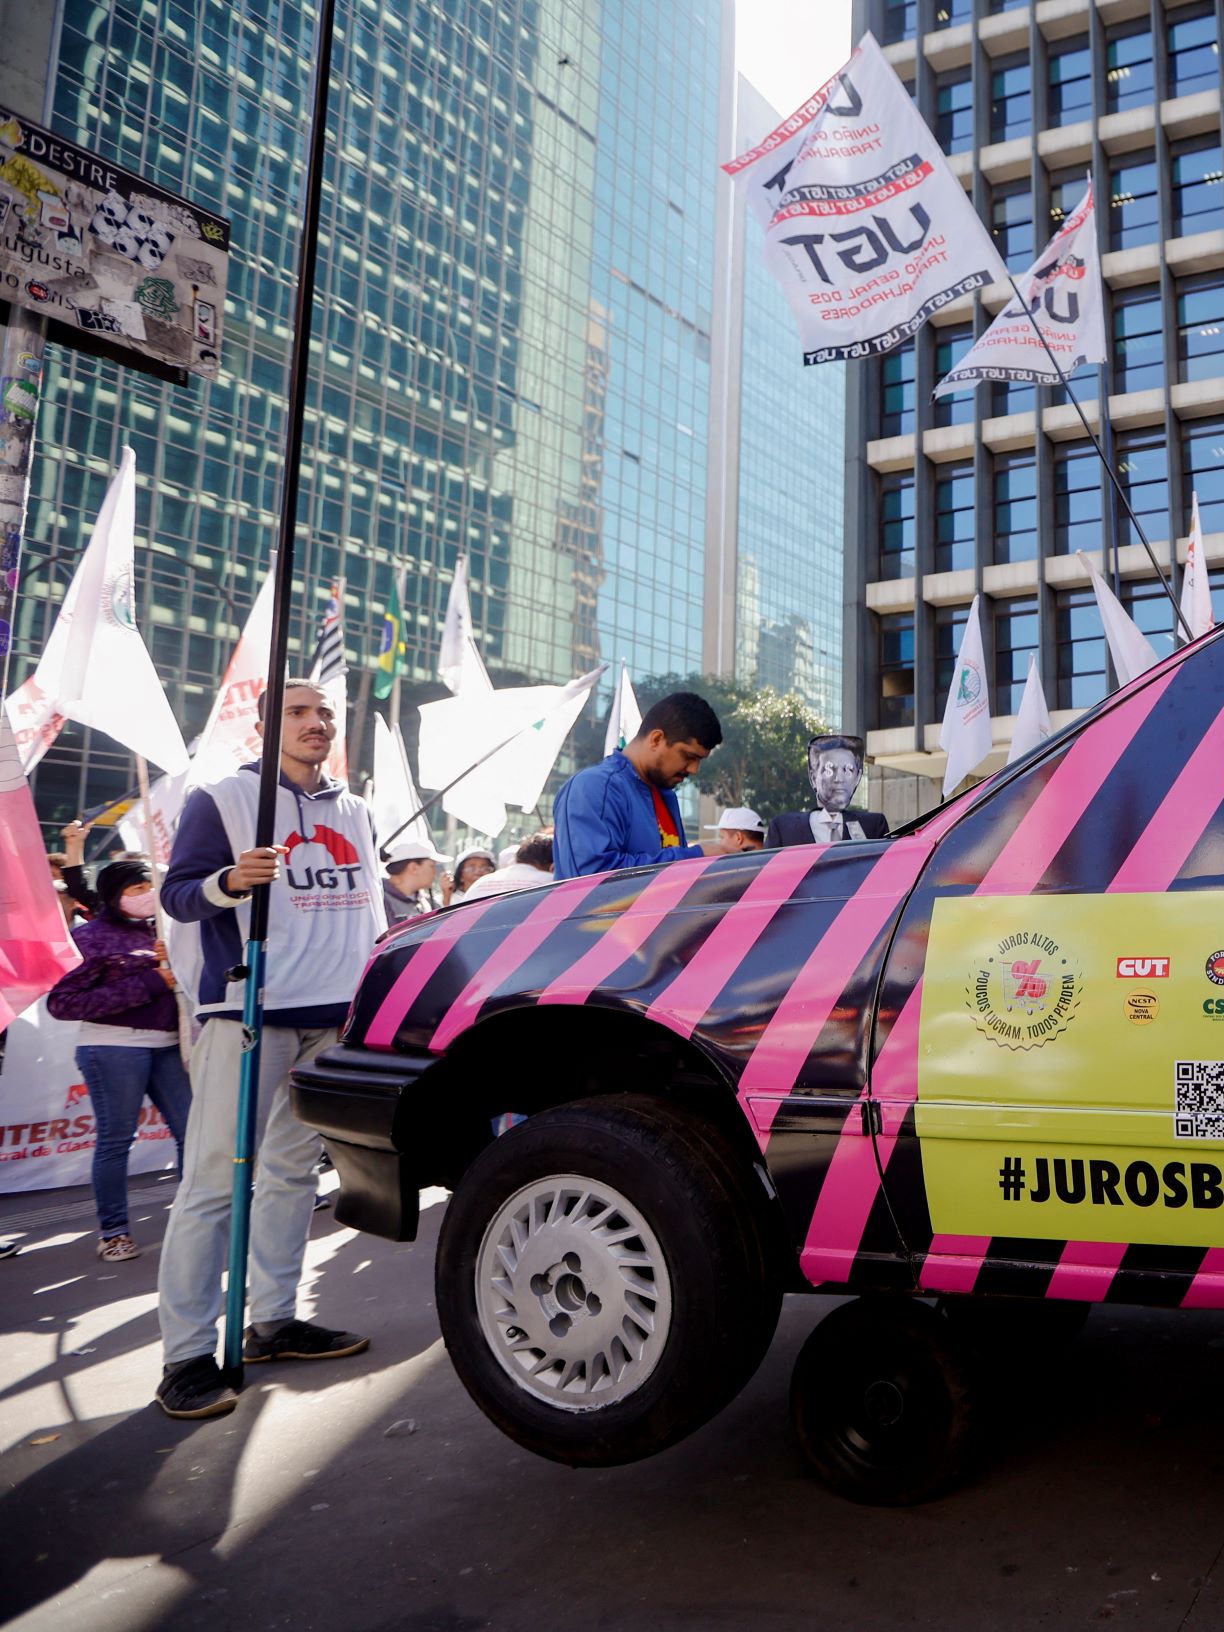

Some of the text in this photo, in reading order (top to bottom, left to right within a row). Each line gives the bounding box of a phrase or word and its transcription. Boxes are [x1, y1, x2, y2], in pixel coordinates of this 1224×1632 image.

[4, 240, 90, 286] ugusta,
[286, 866, 362, 891] UGT
[998, 932, 1059, 956] JUROS ALTOS
[1118, 958, 1168, 977] CUT
[975, 970, 1075, 1041] POUCOS LUCRAM, TODOS PERDEM
[56, 1138, 97, 1154] Class
